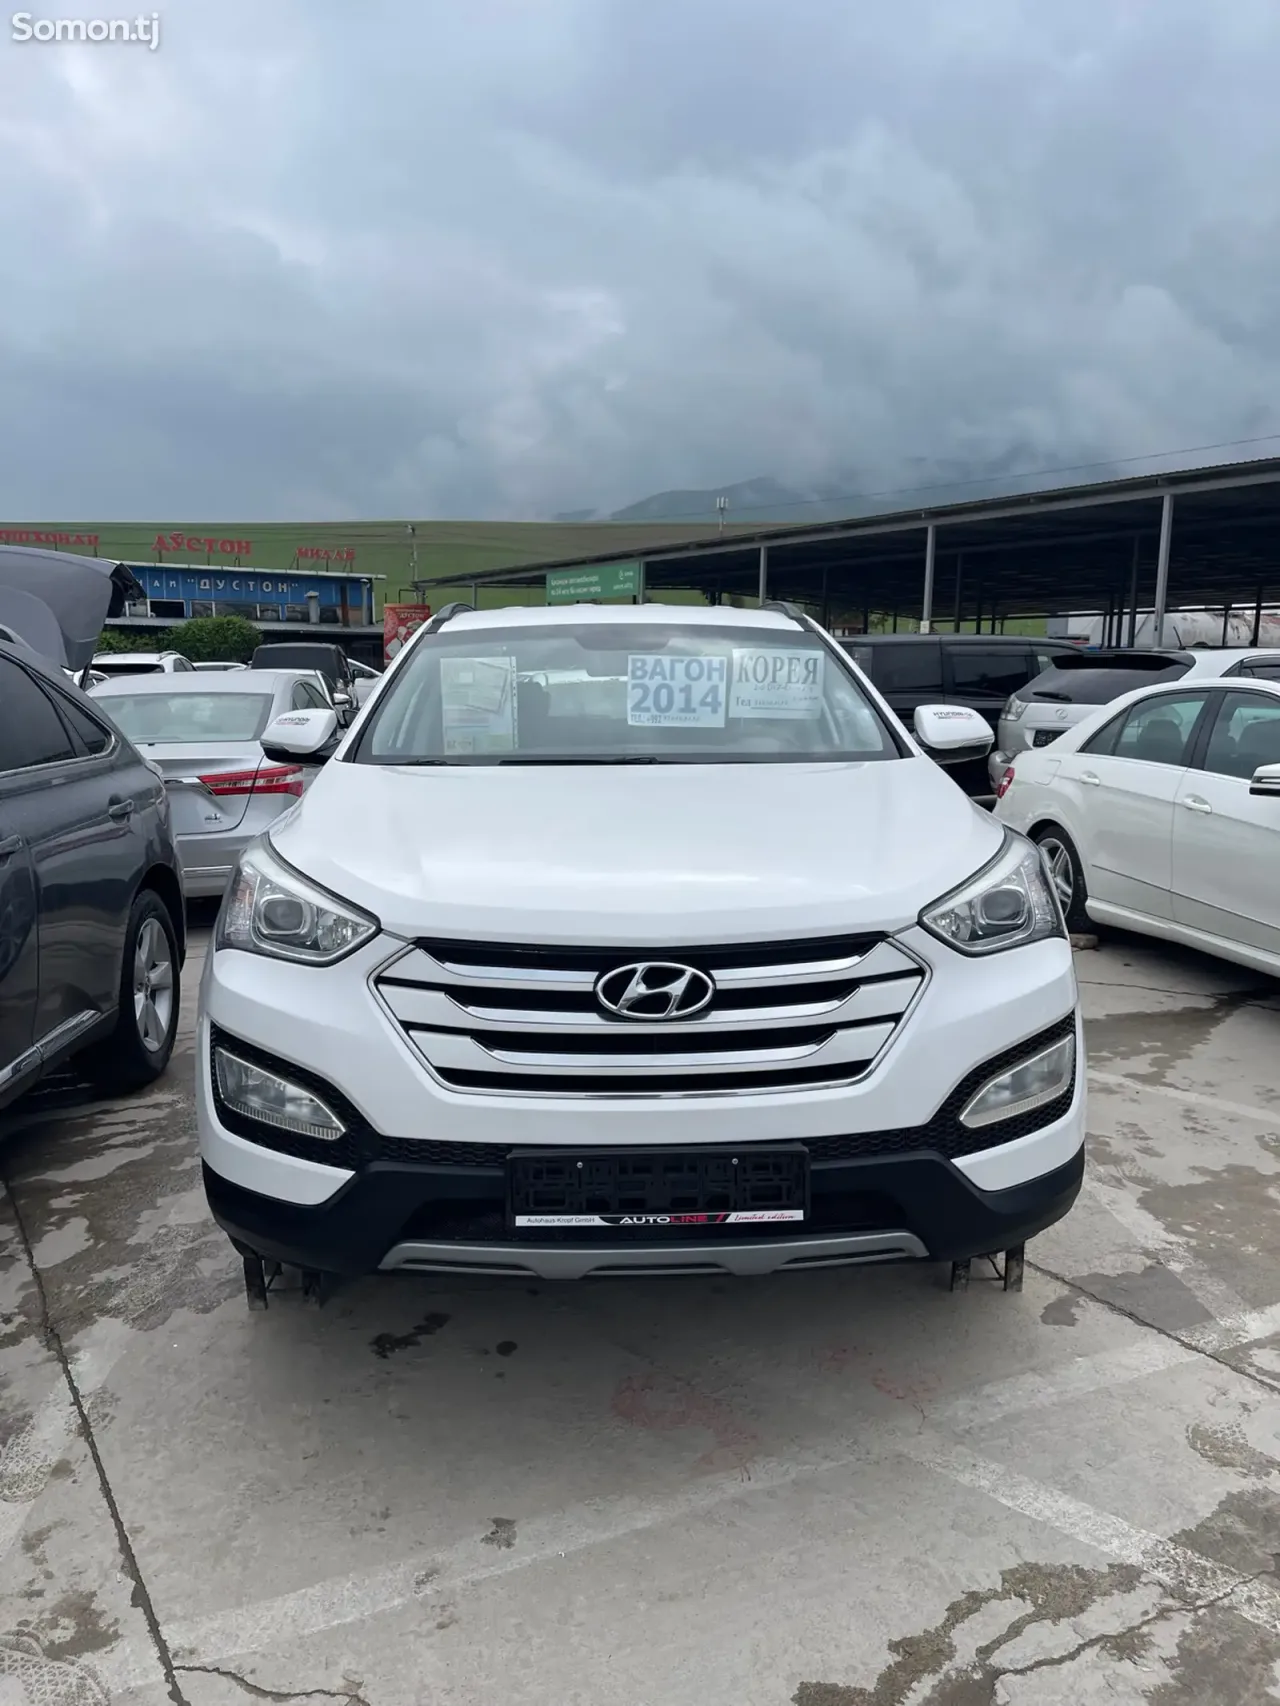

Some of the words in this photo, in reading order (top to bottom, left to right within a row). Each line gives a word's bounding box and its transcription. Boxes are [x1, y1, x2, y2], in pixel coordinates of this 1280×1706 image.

[631, 657, 724, 683] ВАГОН
[737, 655, 819, 685] КОРЕЯ
[631, 683, 723, 714] 2014
[619, 1215, 708, 1224] AUTOLINE
